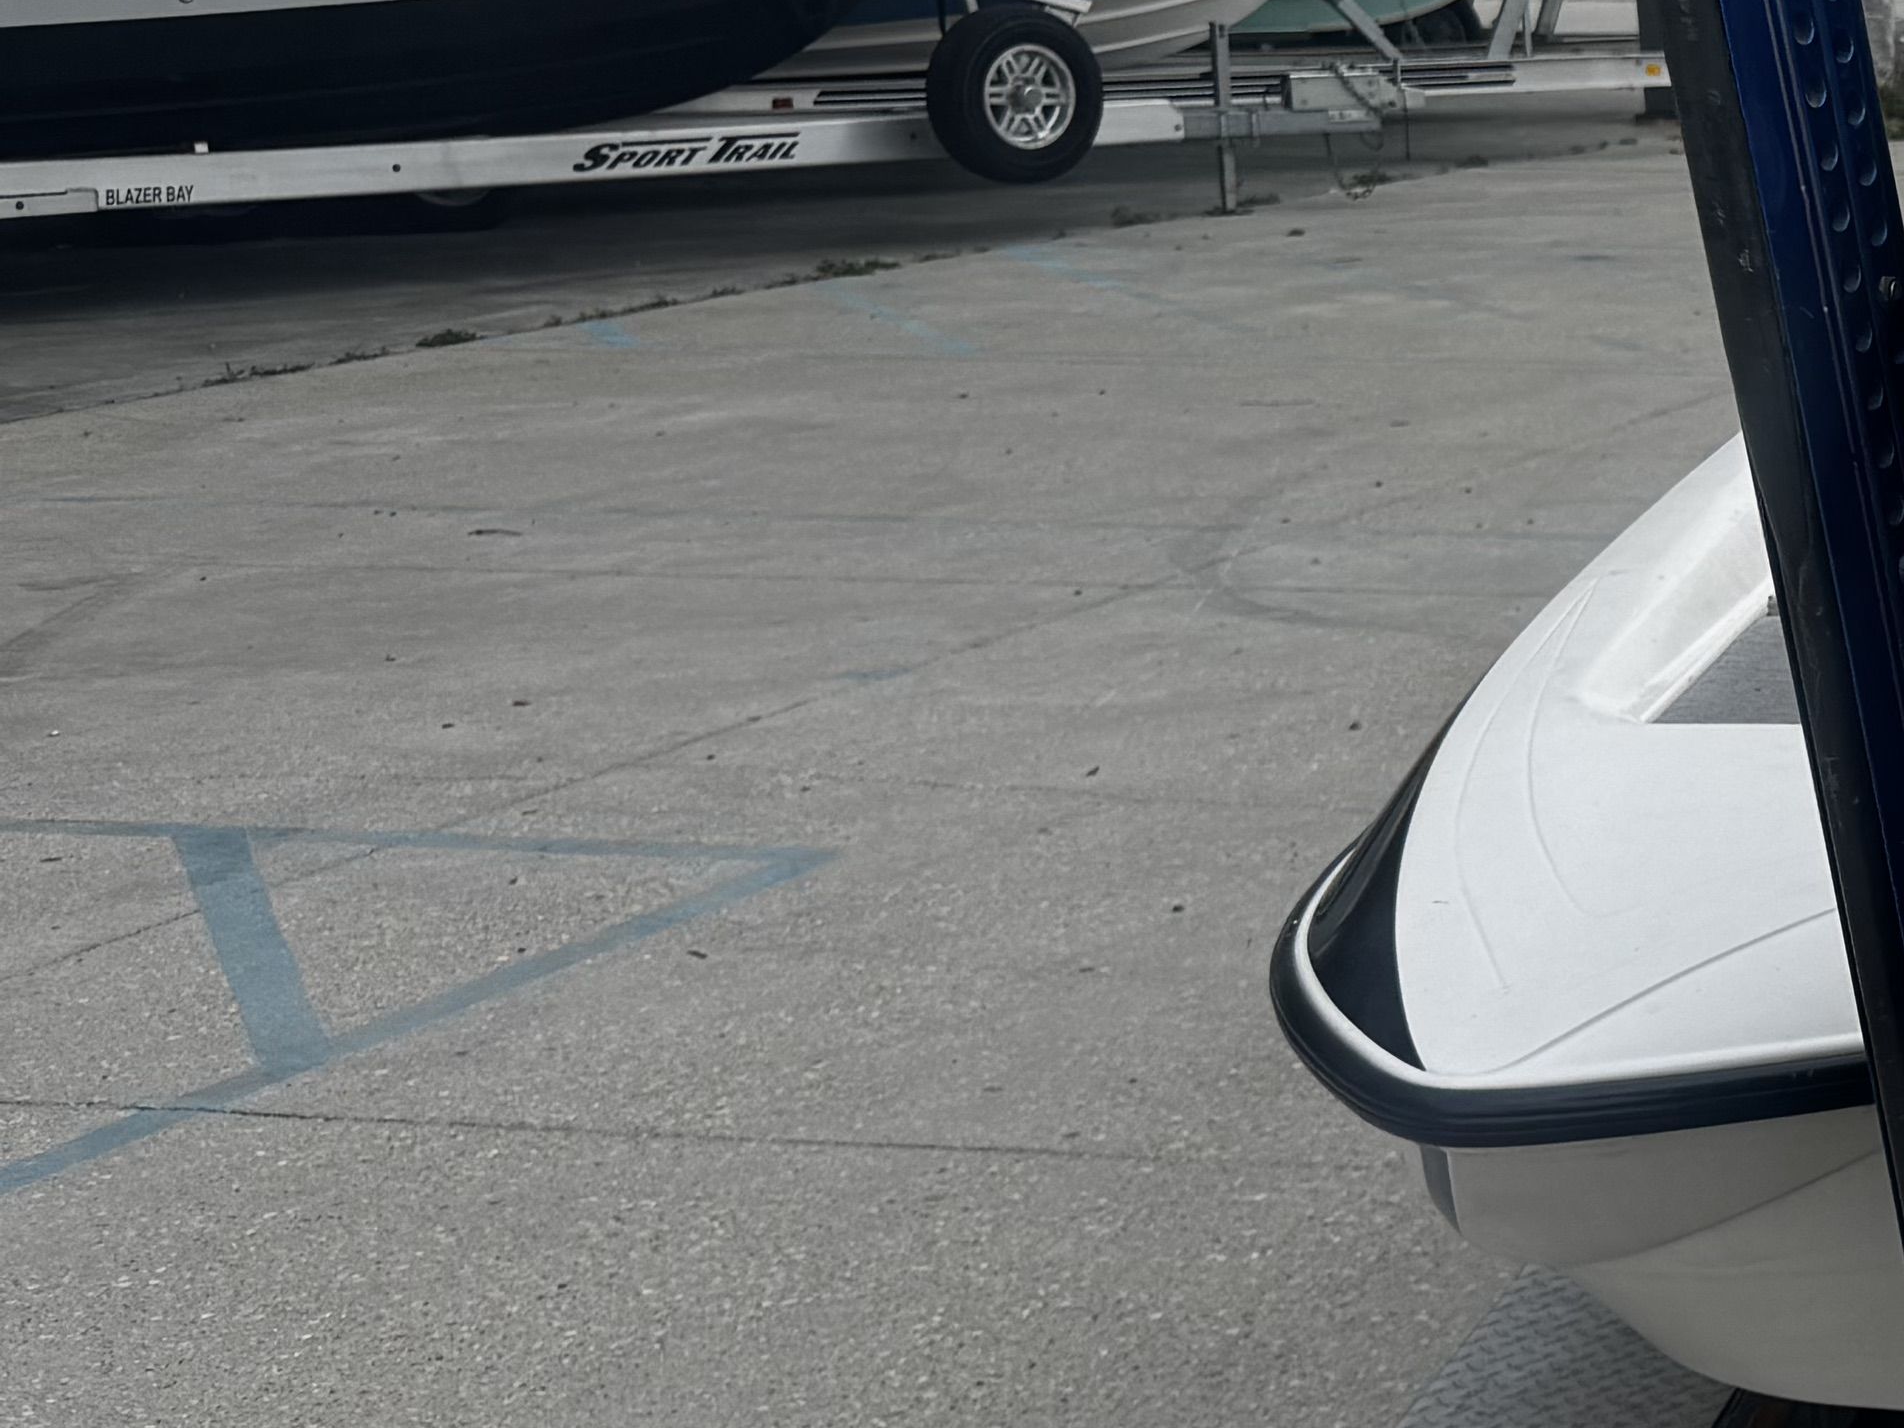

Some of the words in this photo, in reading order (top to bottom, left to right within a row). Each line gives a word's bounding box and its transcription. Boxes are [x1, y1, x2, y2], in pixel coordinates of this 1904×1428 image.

[573, 136, 711, 172] SPORT
[707, 132, 800, 165] TRAIL
[106, 188, 162, 206] BLAZER
[166, 185, 194, 203] BAY
